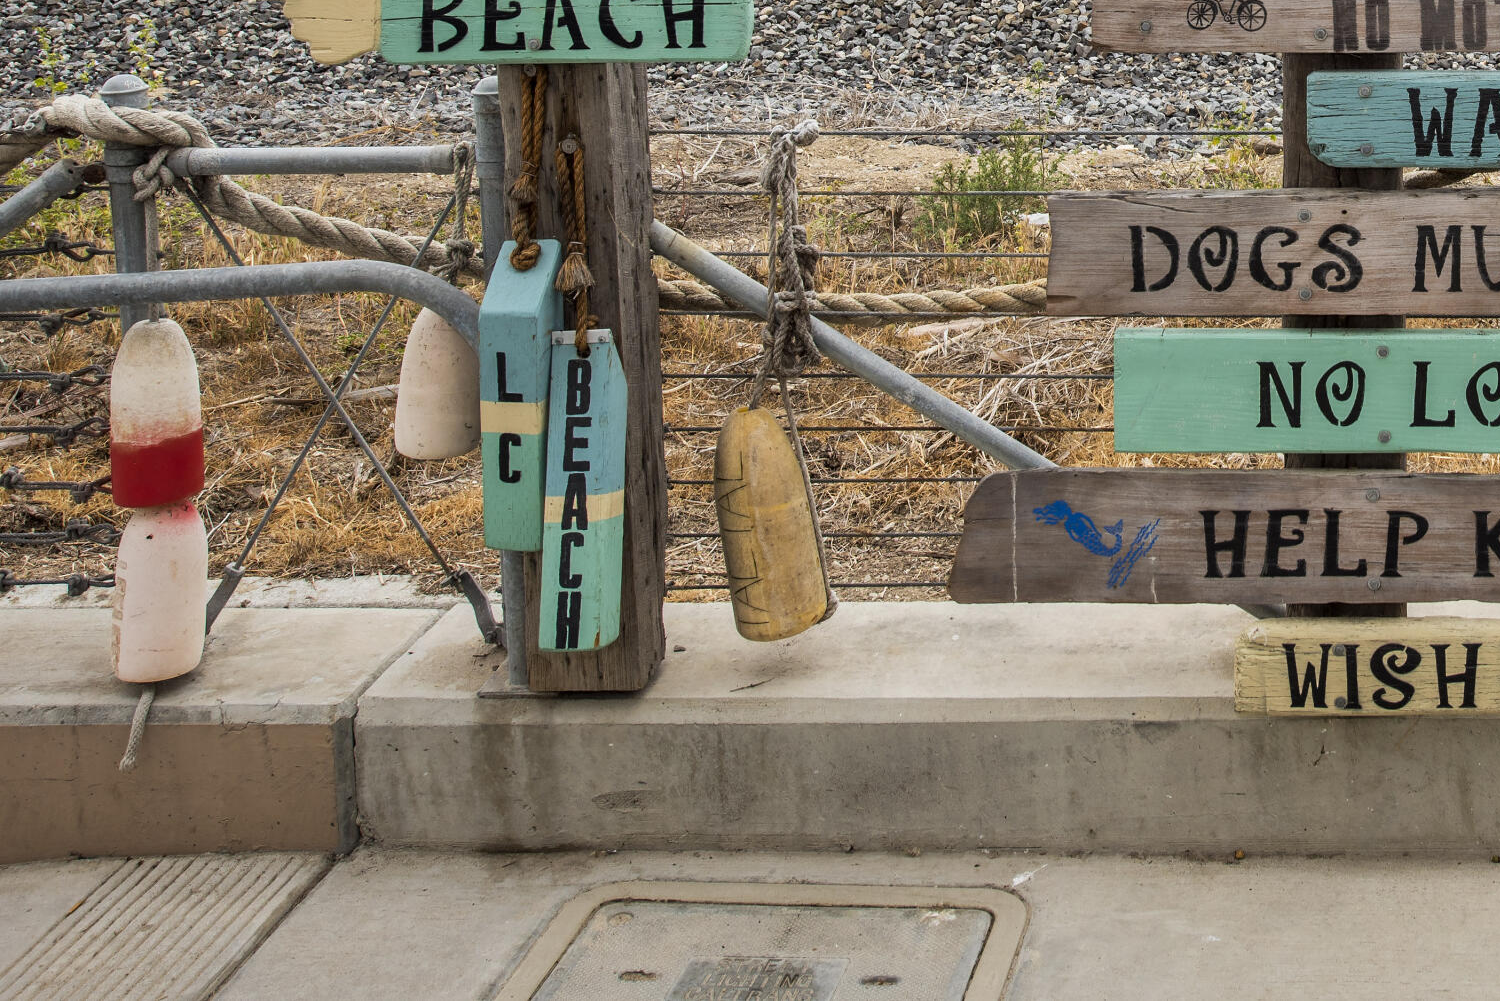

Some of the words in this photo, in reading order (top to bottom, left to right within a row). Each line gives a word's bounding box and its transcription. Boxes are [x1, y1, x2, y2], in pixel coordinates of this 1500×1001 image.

[1129, 224, 1363, 292] DOGS
[1256, 361, 1366, 427] NO
[556, 359, 592, 649] BEACH
[1200, 509, 1428, 578] HELP
[1282, 643, 1480, 710] WISH
[683, 987, 815, 1001] CALTRANS
[702, 973, 813, 988] LIGHTING
